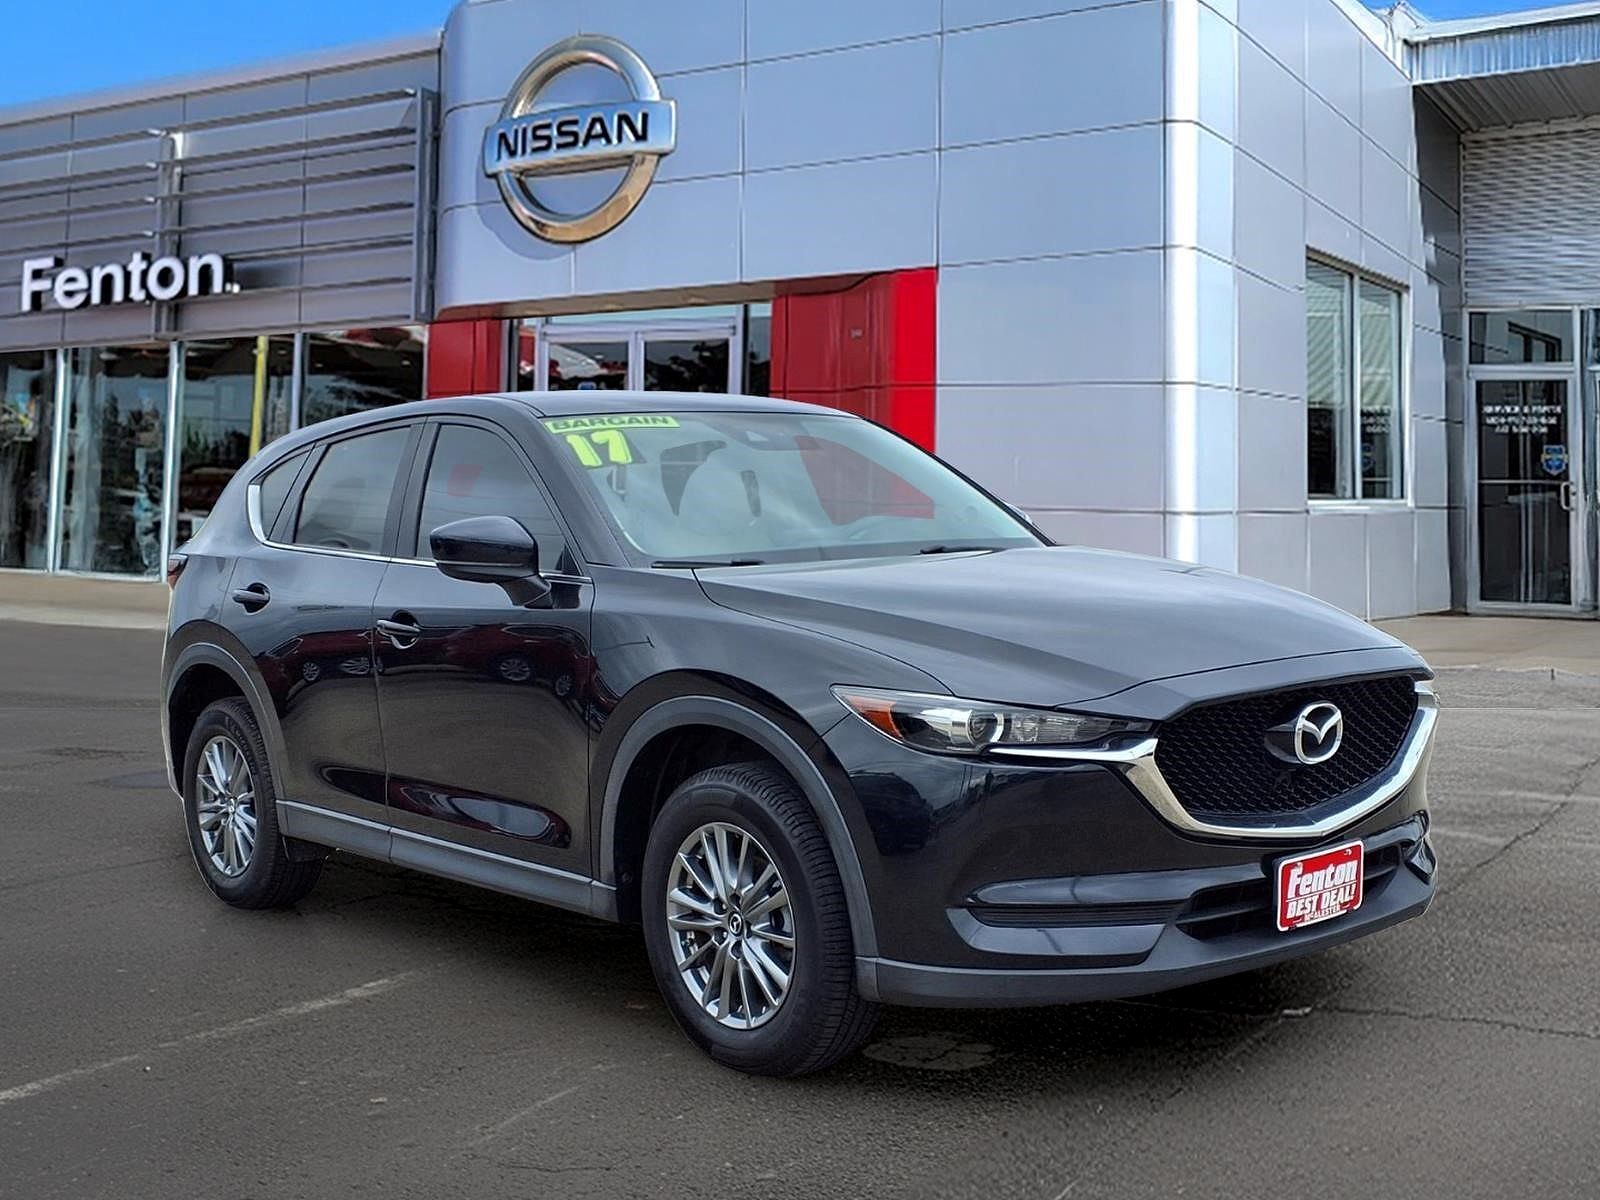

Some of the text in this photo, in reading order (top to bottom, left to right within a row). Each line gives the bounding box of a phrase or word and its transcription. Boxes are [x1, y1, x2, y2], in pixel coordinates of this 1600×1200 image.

[496, 111, 649, 162] NISSAN
[552, 415, 668, 430] BARGAIN
[566, 429, 633, 467] 17
[1287, 860, 1358, 899] Fenton
[1286, 883, 1356, 919] BEST DEAL!
